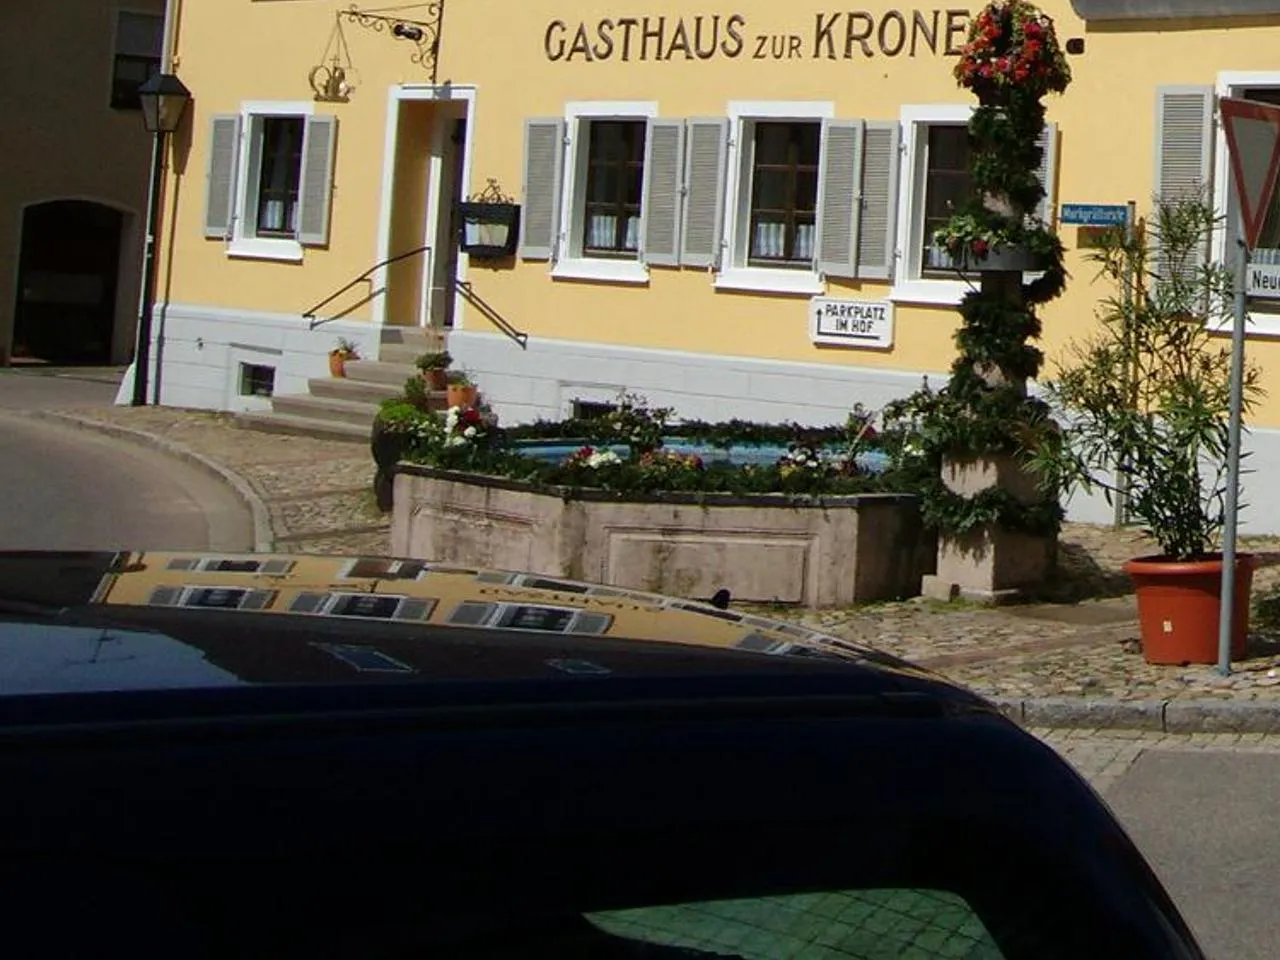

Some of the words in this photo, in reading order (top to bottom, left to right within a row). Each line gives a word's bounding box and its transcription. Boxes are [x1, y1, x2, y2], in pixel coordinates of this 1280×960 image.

[544, 14, 745, 62] GASTHAUS
[752, 35, 802, 59] ZUR
[812, 9, 970, 60] KRONE
[825, 304, 886, 321] PARKPLATZ
[836, 319, 849, 332] IM
[852, 319, 874, 333] HOF
